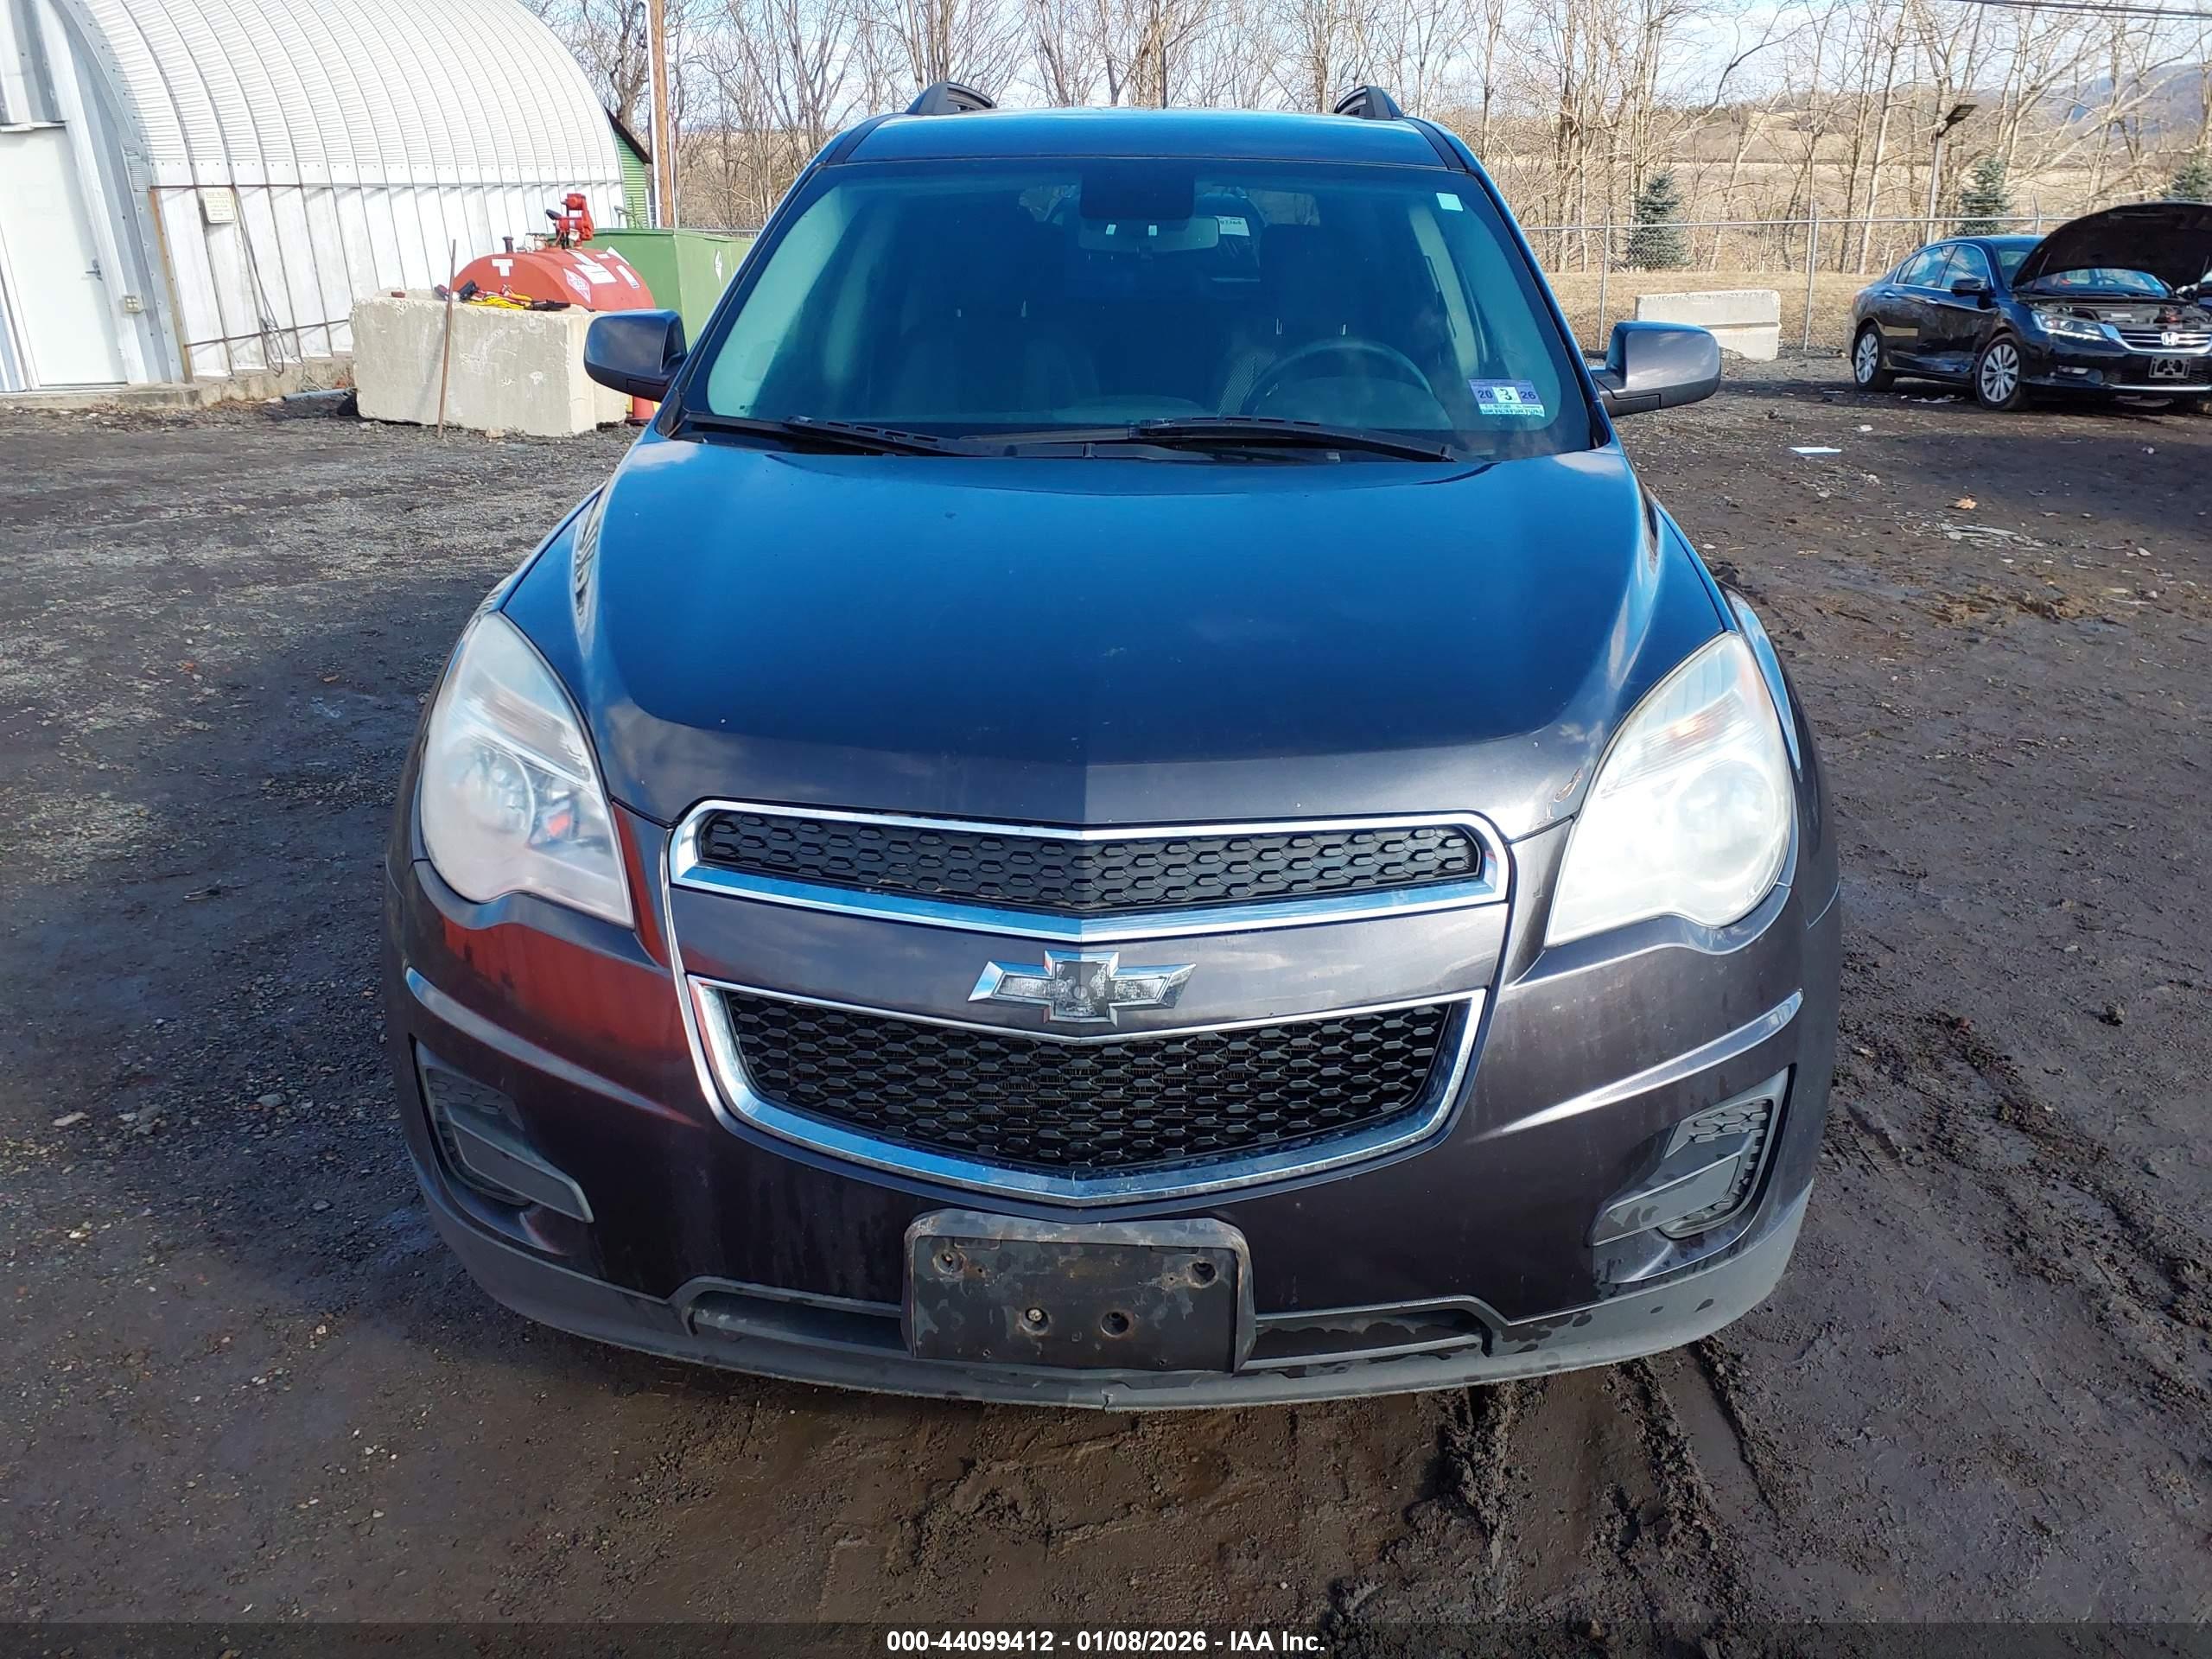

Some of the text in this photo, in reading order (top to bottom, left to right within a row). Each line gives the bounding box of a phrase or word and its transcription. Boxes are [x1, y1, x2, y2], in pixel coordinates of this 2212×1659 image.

[1478, 388, 1536, 401] 20 3 26
